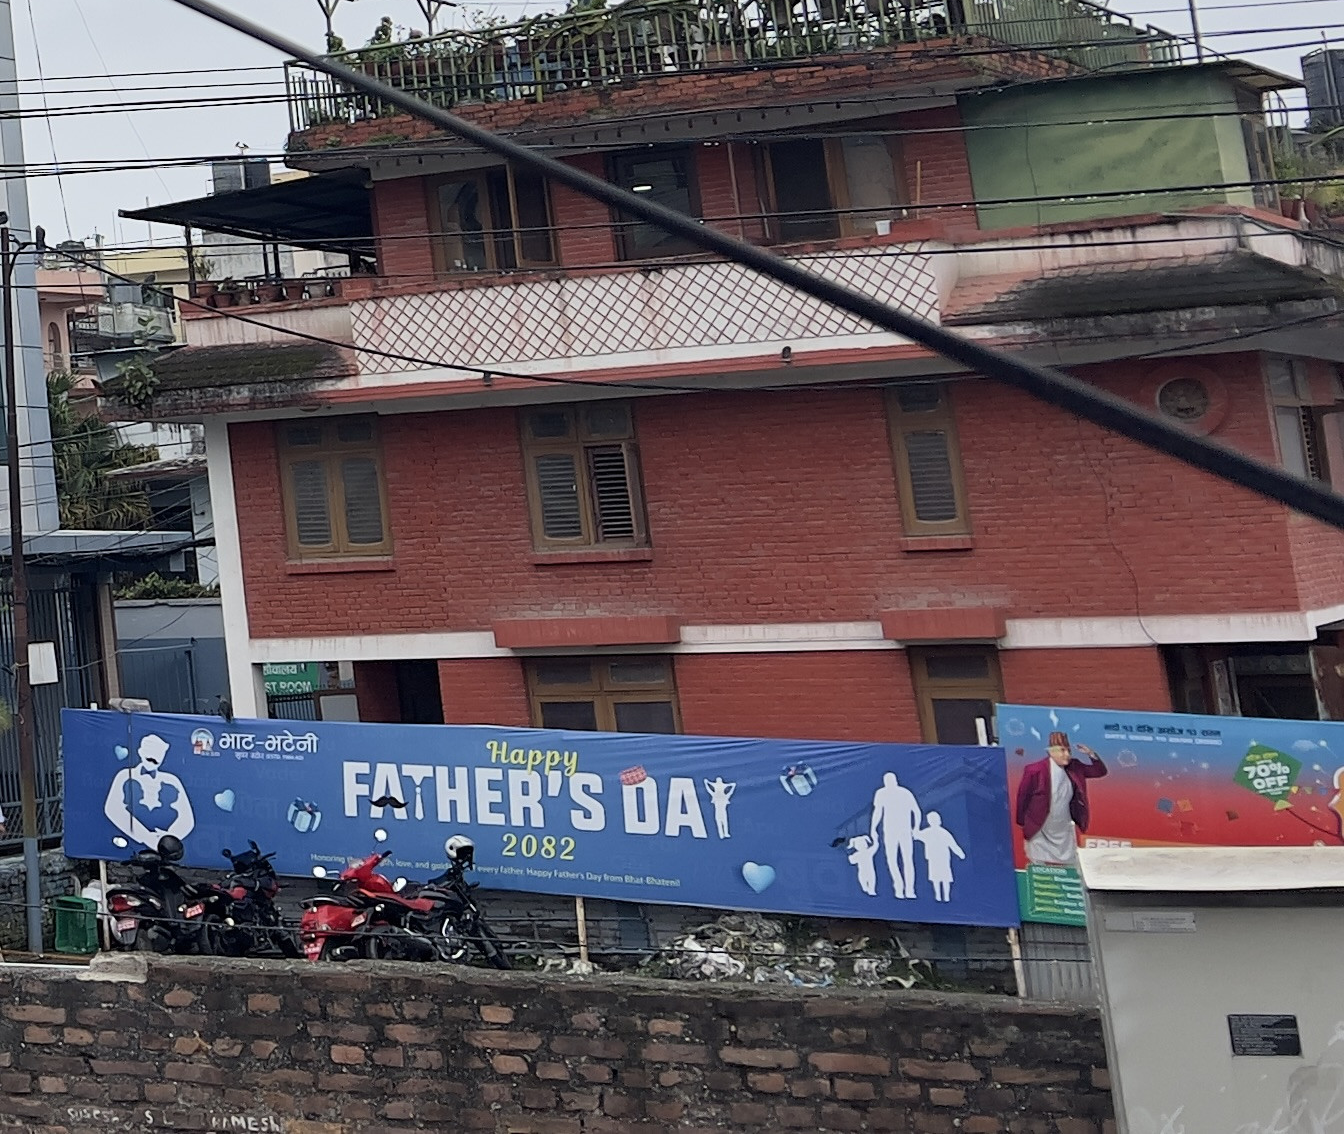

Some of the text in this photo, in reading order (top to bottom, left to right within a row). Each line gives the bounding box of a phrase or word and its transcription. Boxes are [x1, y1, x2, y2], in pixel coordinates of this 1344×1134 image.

[279, 681, 312, 694] ROOM
[219, 729, 319, 753] भाट-भटेनी
[486, 740, 578, 777] Happy
[1243, 762, 1290, 779] 70%
[1253, 775, 1288, 790] OFF
[342, 761, 606, 832] FATHER'S
[502, 833, 576, 861] 2082
[311, 853, 346, 864] Honoring
[415, 860, 430, 869] and
[477, 865, 499, 875] every
[526, 867, 553, 879] Happy
[554, 869, 585, 880] Father's
[586, 871, 602, 882] Day
[603, 873, 623, 882] from
